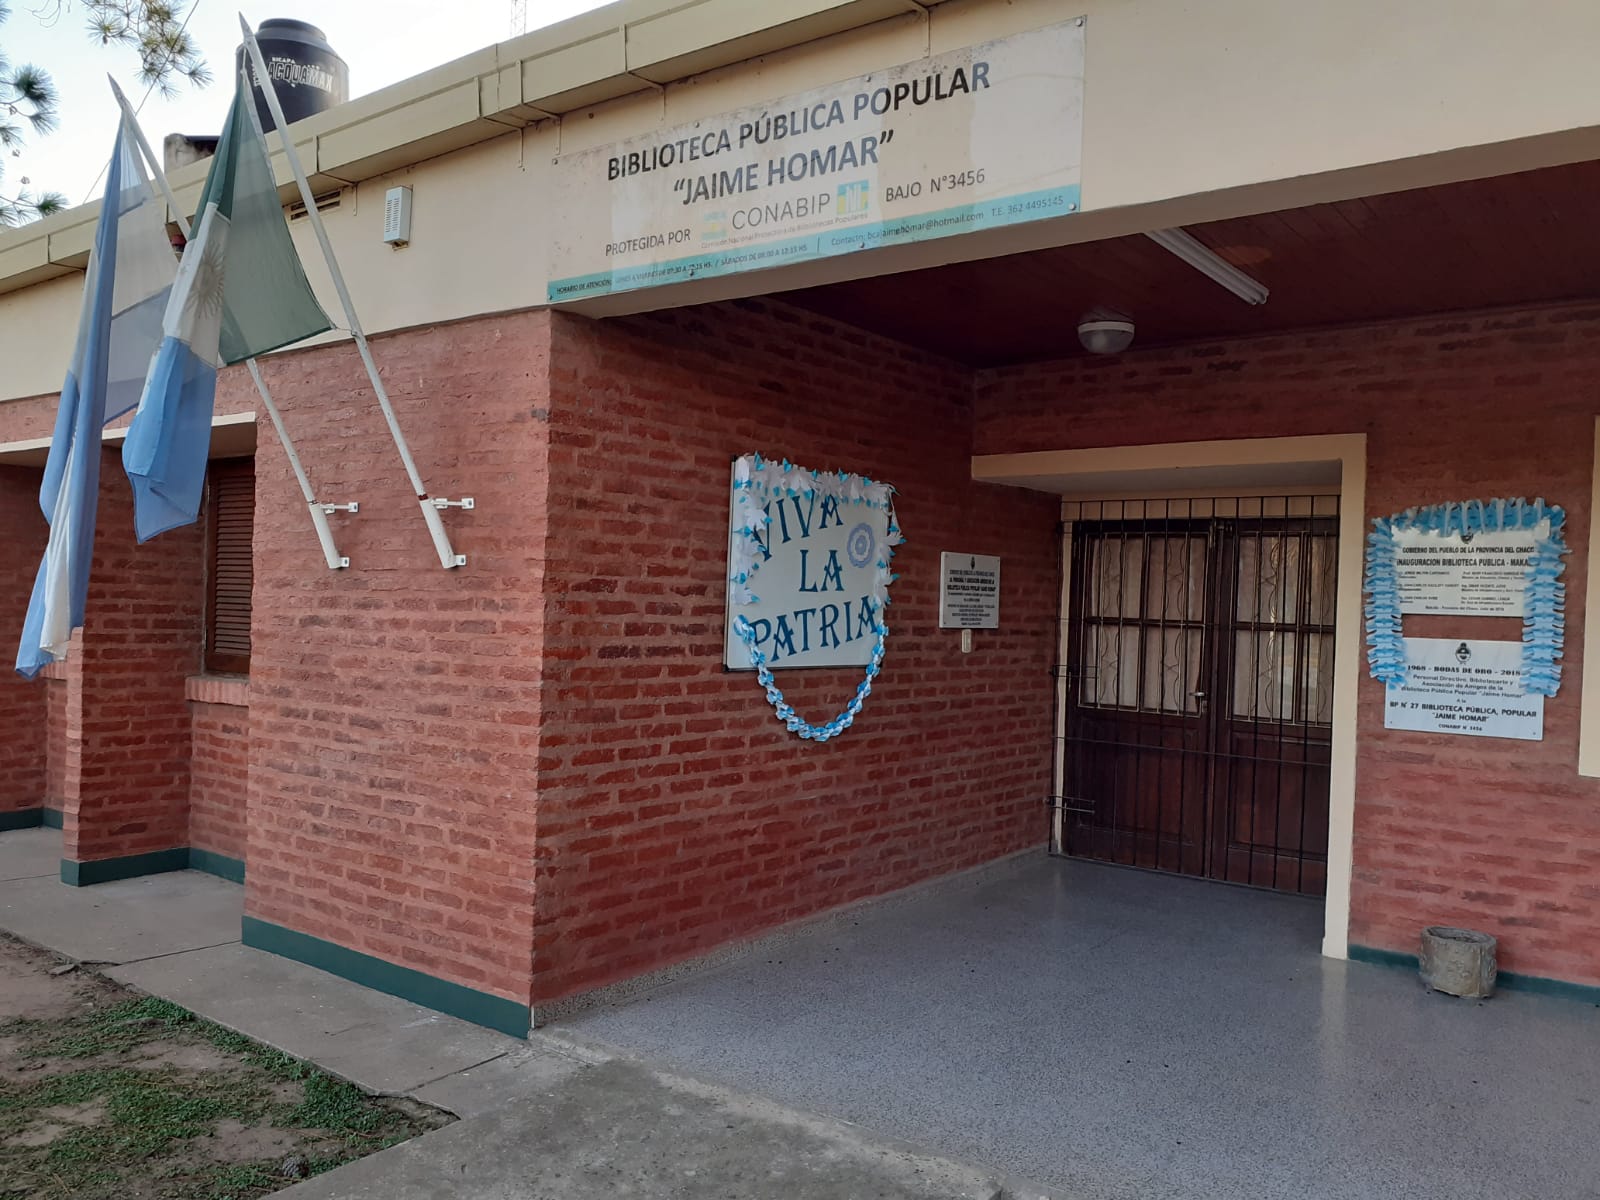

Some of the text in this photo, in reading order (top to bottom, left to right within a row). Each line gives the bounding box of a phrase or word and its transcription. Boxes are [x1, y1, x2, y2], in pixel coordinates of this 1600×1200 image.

[608, 61, 990, 181] BIBLIOTECA PÚBLICA POPULAR
[605, 168, 985, 257] PROTEGIDA POR CONABIP BAJO N°3456
[752, 488, 844, 562] VIVA
[798, 549, 845, 592] LA
[1442, 558, 1477, 567] BIBLIOTECA
[749, 595, 879, 662] PATRIA
[1422, 703, 1463, 712] BIBLIOTECA
[1501, 709, 1537, 717] POPULAR
